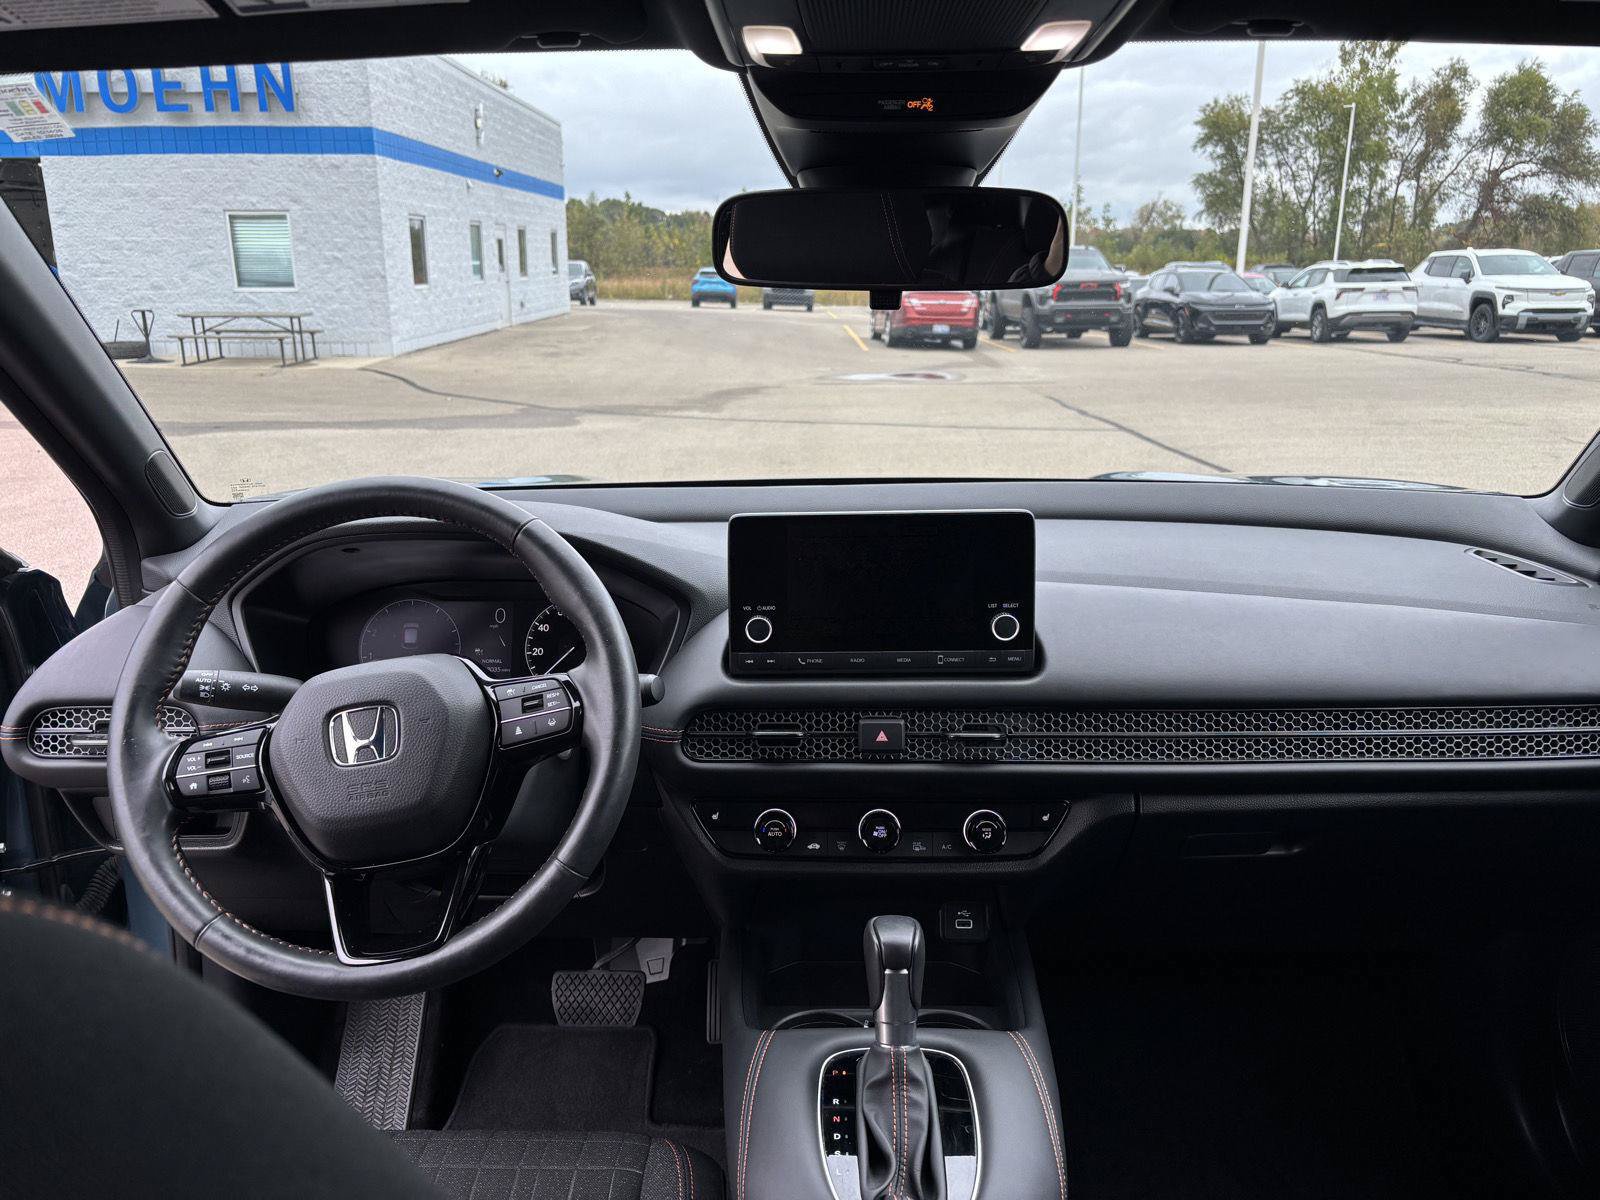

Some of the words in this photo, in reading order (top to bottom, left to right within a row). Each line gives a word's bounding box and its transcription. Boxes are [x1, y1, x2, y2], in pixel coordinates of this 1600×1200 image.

[34, 62, 296, 113] MOEHN
[495, 607, 506, 624] 0
[537, 623, 550, 632] 40
[532, 647, 544, 656] 20
[236, 752, 254, 760] SOURCE
